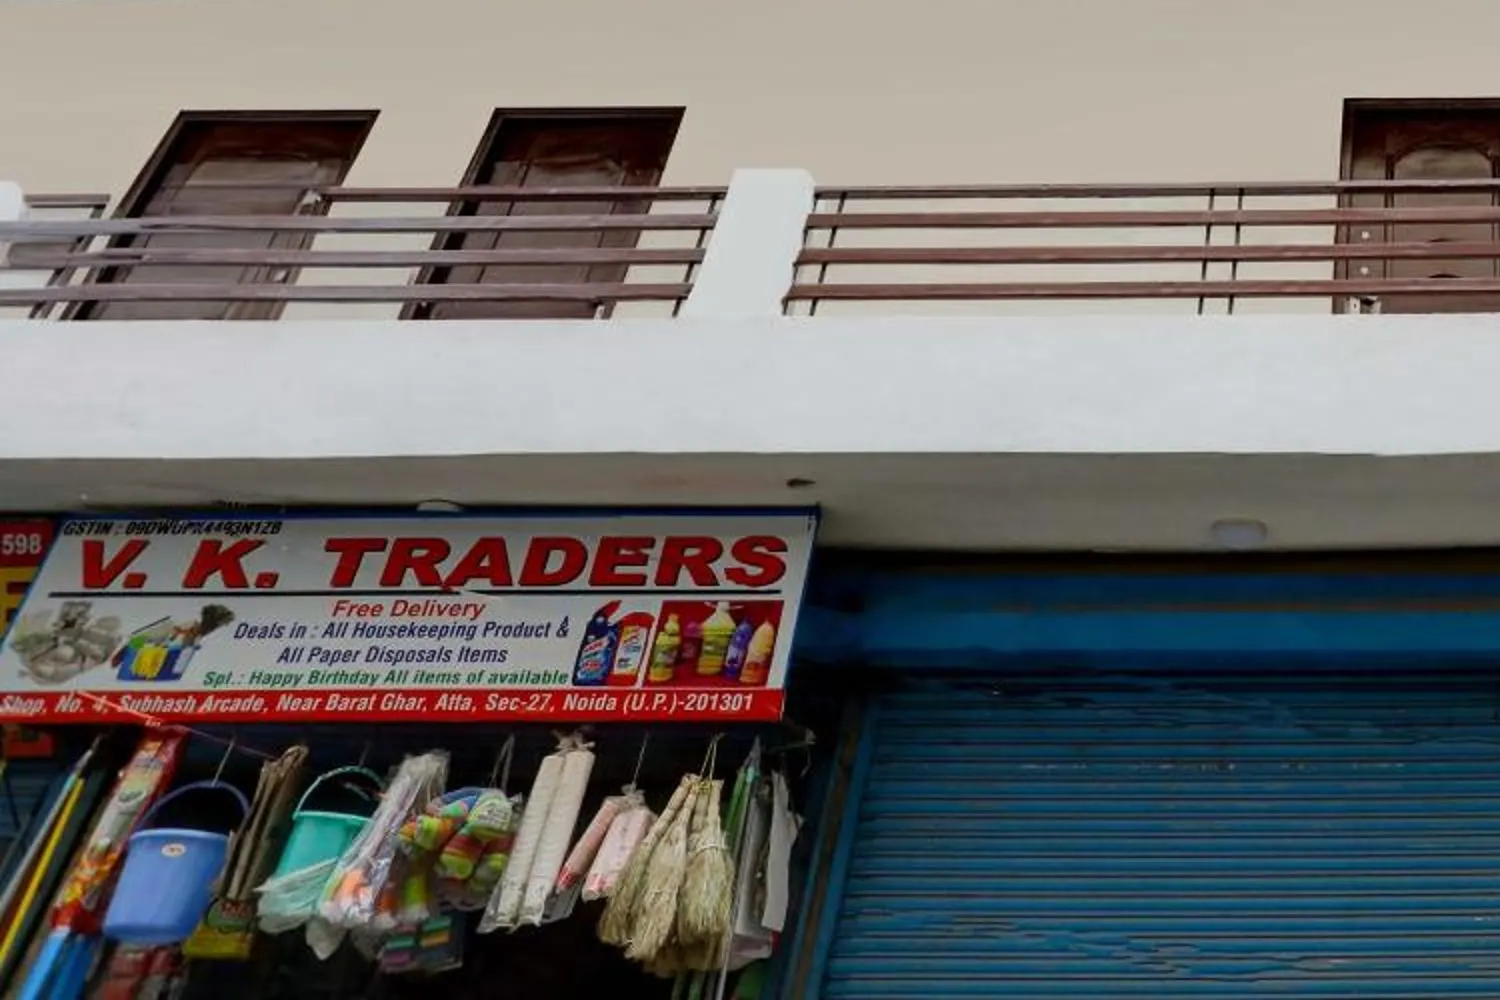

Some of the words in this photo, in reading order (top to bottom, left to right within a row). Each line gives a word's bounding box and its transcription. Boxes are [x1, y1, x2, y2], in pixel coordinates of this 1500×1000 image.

[81, 539, 149, 589] V.
[182, 539, 279, 588] K.
[323, 535, 788, 588] TRADERS
[332, 600, 384, 617] Free
[390, 600, 486, 621] Delivery
[234, 622, 286, 640] Deals
[289, 622, 307, 639] in
[321, 621, 348, 638] All
[352, 620, 476, 641] Housekeeping
[482, 621, 552, 638] Product
[277, 647, 304, 664] All
[307, 646, 361, 667] Paper
[365, 645, 452, 667] Disposals
[457, 645, 508, 663] Items
[249, 670, 304, 687] Happy
[307, 668, 380, 686] Birthday
[384, 669, 409, 685] All
[413, 669, 462, 685] items
[466, 668, 485, 685] of
[487, 668, 569, 685] available
[54, 694, 85, 713] No.
[117, 695, 197, 714] Subhash
[200, 694, 269, 713] Arcade,
[276, 693, 323, 711] Near
[325, 693, 374, 711] Barat
[380, 692, 428, 712] Ghar,
[434, 692, 477, 712] Atta,
[485, 692, 556, 713] Sec-27,
[562, 693, 617, 711] Noida
[622, 692, 753, 715] (U.P.)-201301
